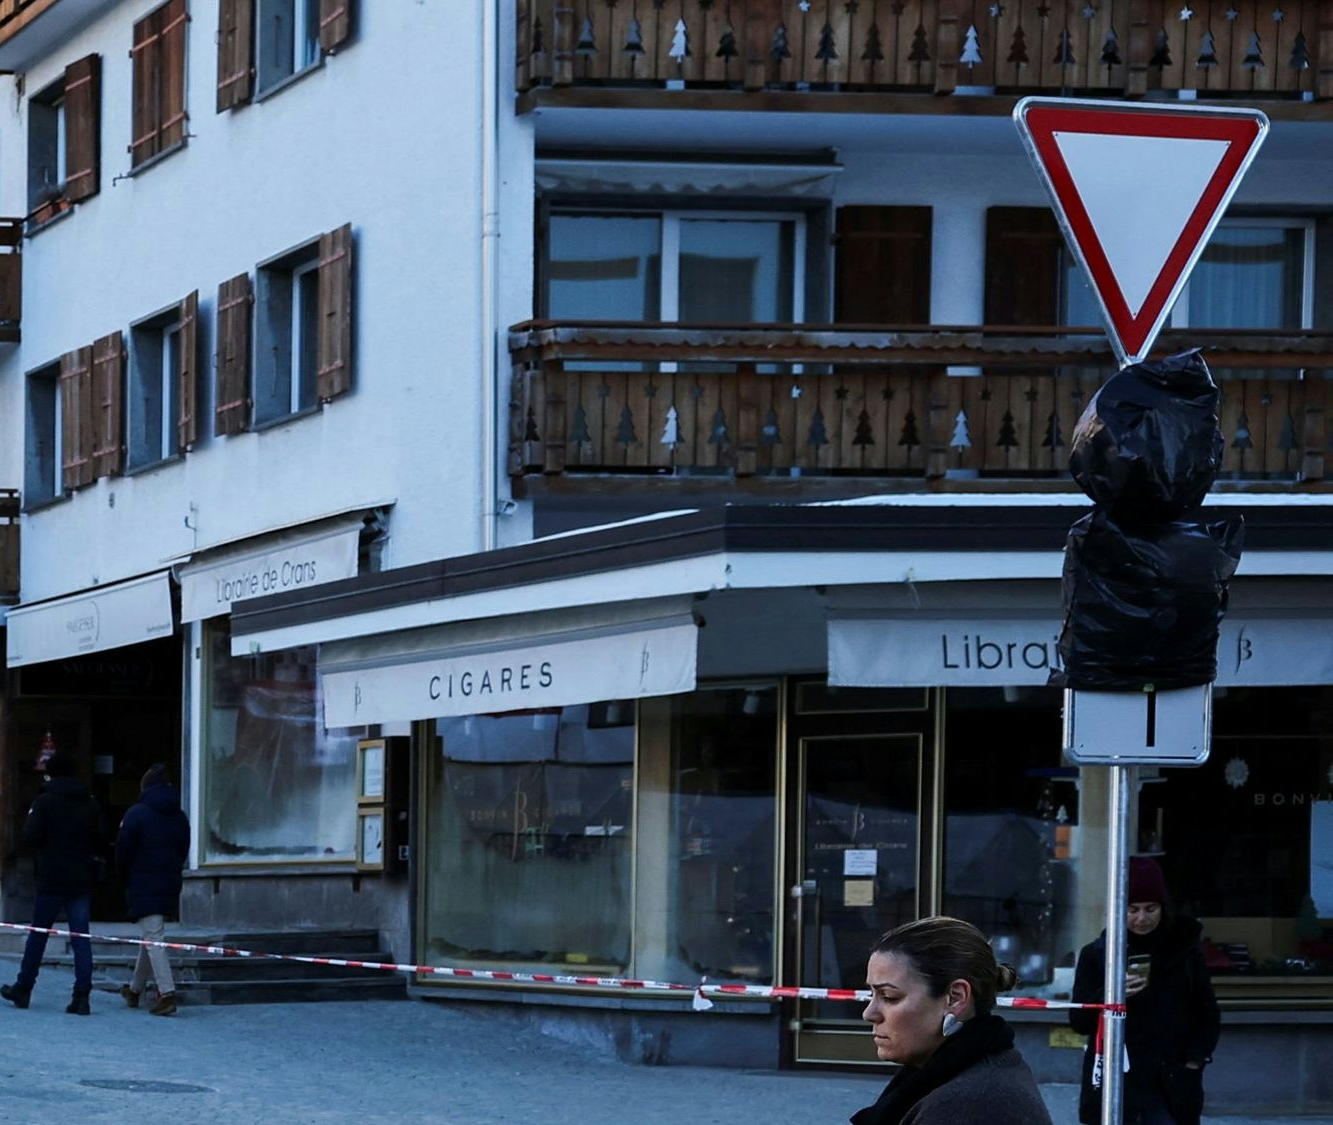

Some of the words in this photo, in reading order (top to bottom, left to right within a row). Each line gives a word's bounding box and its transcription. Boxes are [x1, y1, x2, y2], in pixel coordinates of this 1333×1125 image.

[216, 574, 259, 602] Librairie
[262, 567, 278, 591] de
[281, 558, 317, 587] Crans
[942, 634, 1061, 670] Librai
[429, 662, 553, 700] CIGARES
